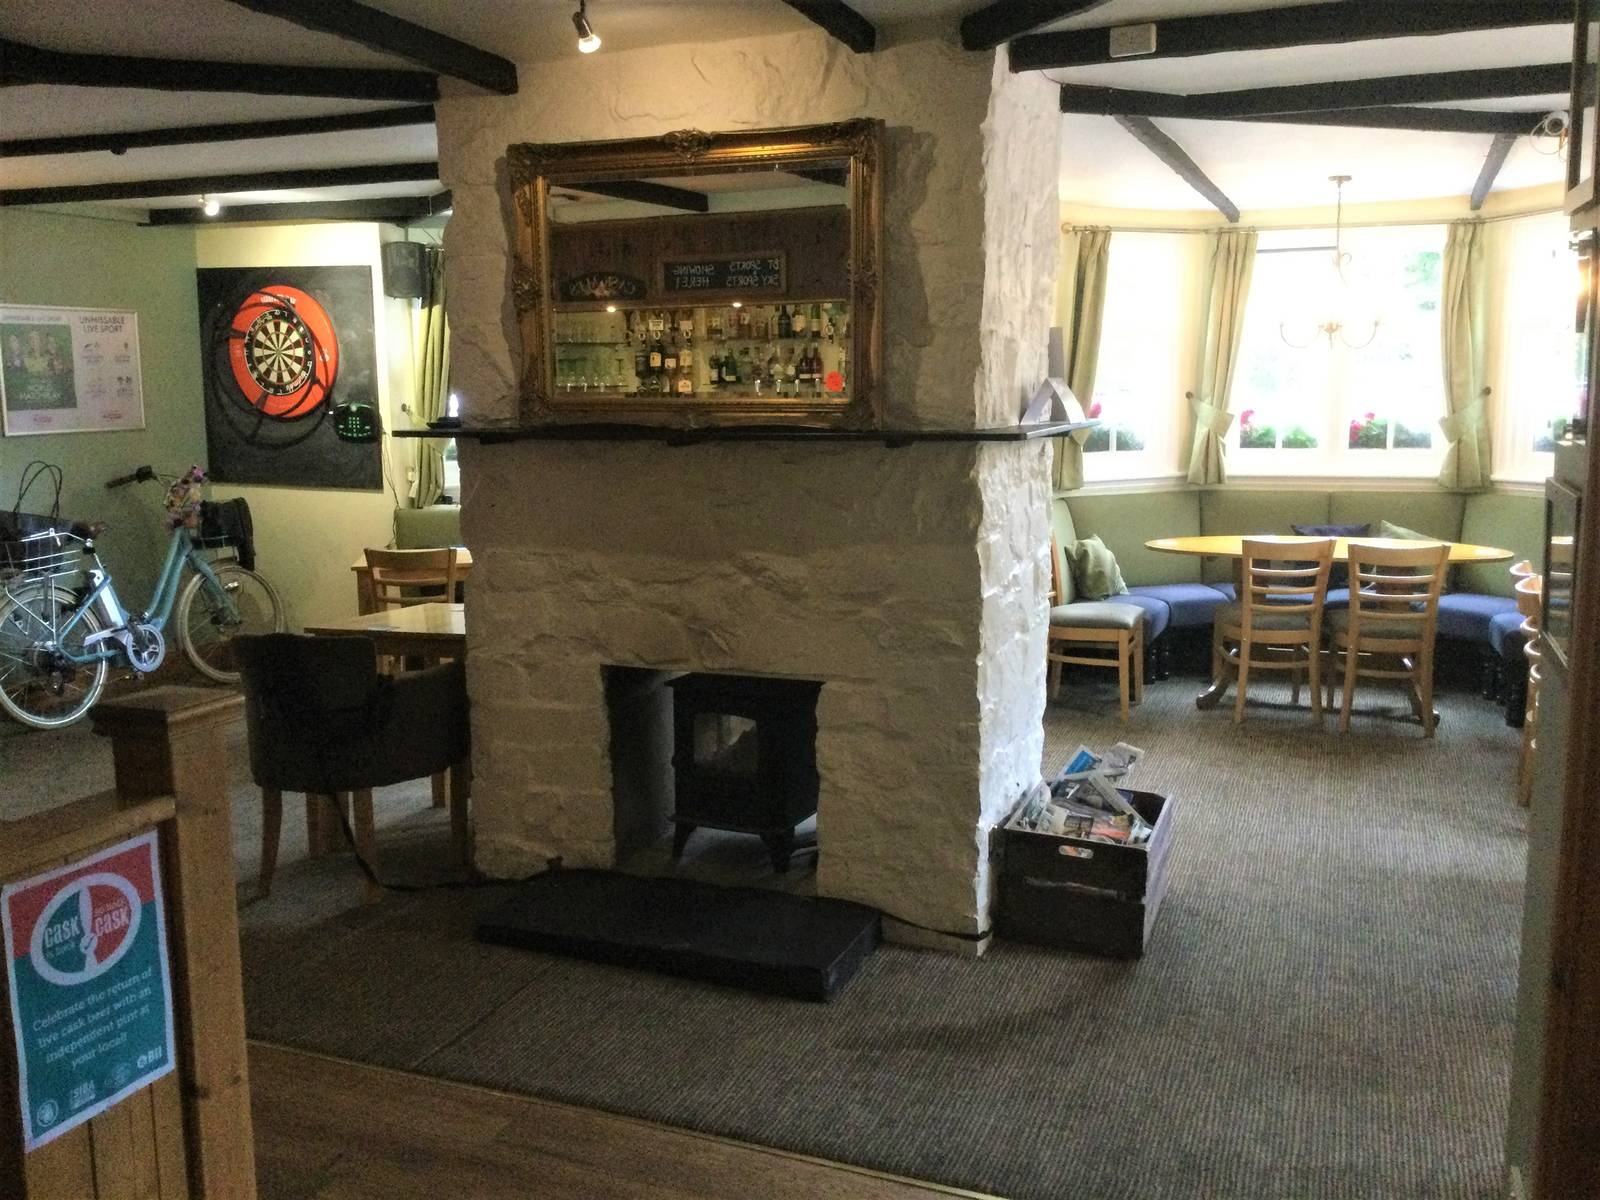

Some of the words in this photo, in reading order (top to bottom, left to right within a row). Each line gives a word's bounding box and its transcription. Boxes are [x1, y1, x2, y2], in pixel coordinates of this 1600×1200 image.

[33, 1001, 86, 1031] Celebrate
[87, 991, 106, 1005] the
[107, 975, 140, 996] return
[141, 967, 152, 979] of
[61, 1018, 86, 1037] cask
[87, 1006, 111, 1023] beer
[112, 994, 137, 1010] with
[46, 1021, 114, 1063] independent
[115, 1010, 138, 1029] pint
[72, 1049, 97, 1070] your
